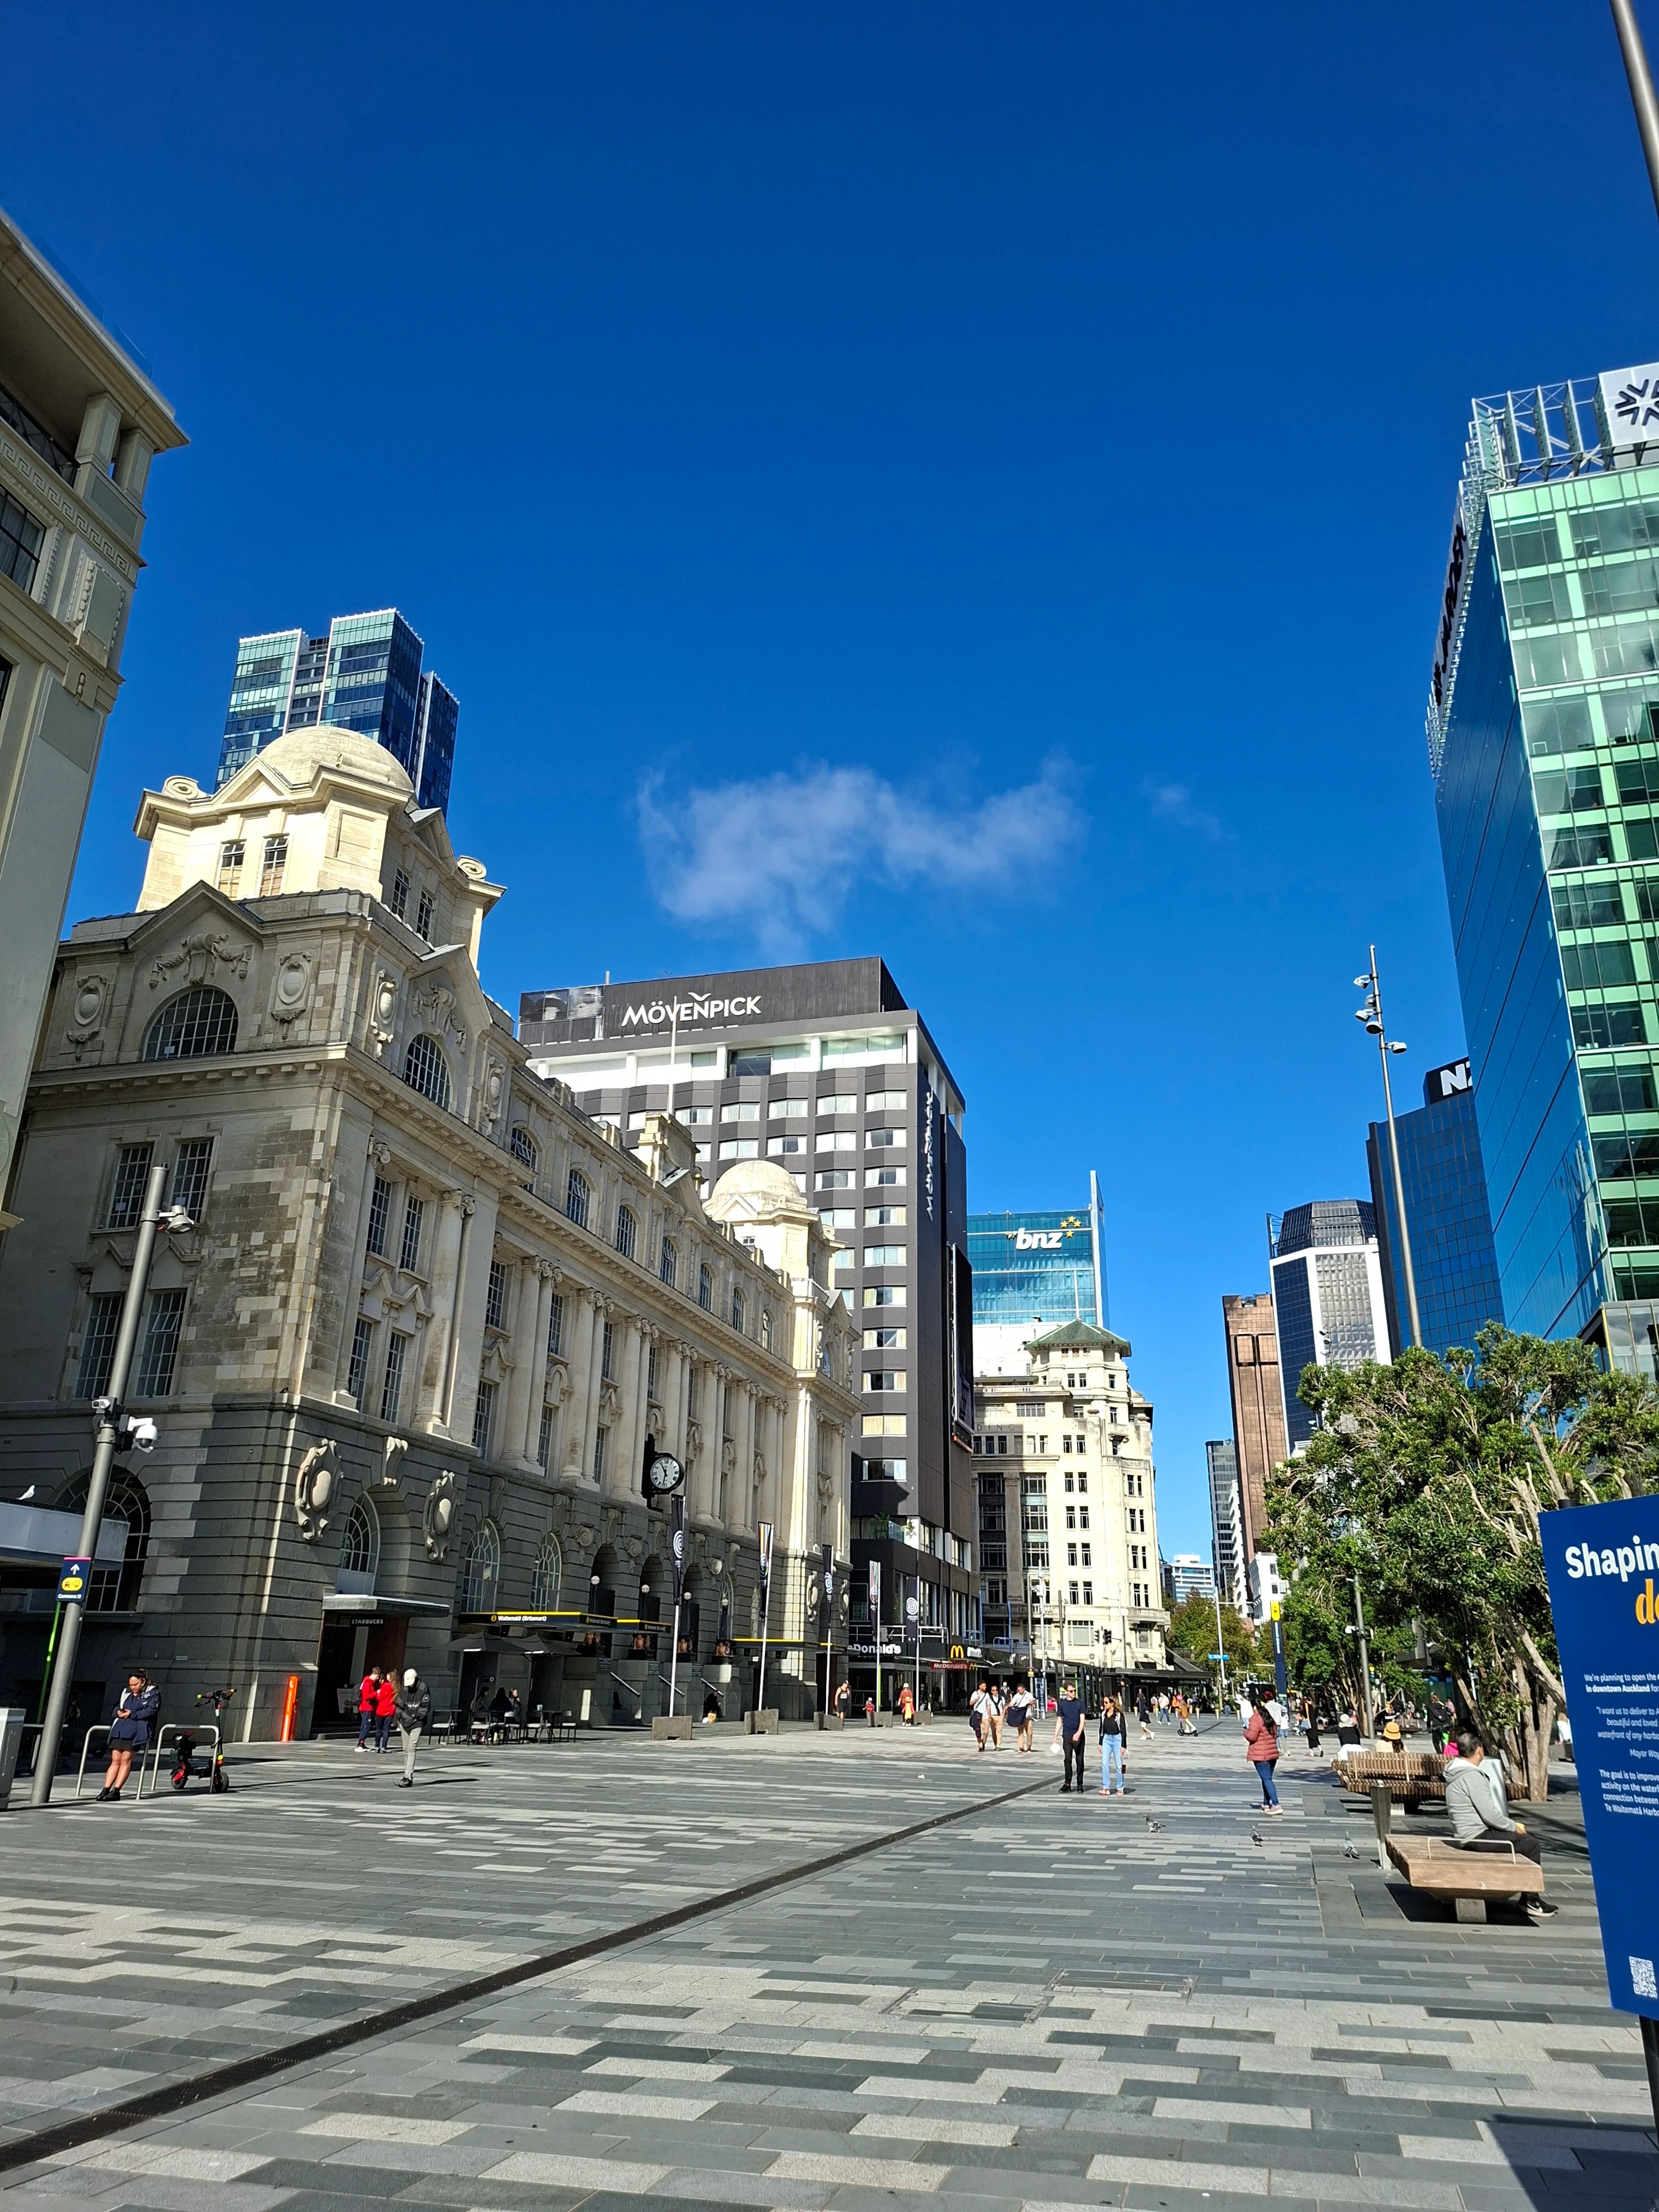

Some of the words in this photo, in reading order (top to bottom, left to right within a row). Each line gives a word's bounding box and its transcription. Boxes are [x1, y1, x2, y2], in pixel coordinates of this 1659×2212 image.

[621, 995, 761, 1027] MÖVENPICK
[1015, 1227, 1063, 1250] bnz
[1566, 1535, 1659, 1583] Shapin
[1600, 1673, 1625, 1683] planning
[1631, 1674, 1646, 1682] open
[1646, 1672, 1657, 1681] the
[1593, 1684, 1622, 1693] downtown
[1622, 1684, 1651, 1692] Auckland
[1629, 1707, 1648, 1715] deliver
[1606, 1717, 1630, 1728] beautiful
[1631, 1718, 1642, 1726] and
[1629, 1749, 1647, 1759] Mayor
[1598, 1769, 1610, 1778] The
[1610, 1770, 1624, 1780] goal
[1603, 1793, 1634, 1802] connection
[1634, 1794, 1659, 1804] between
